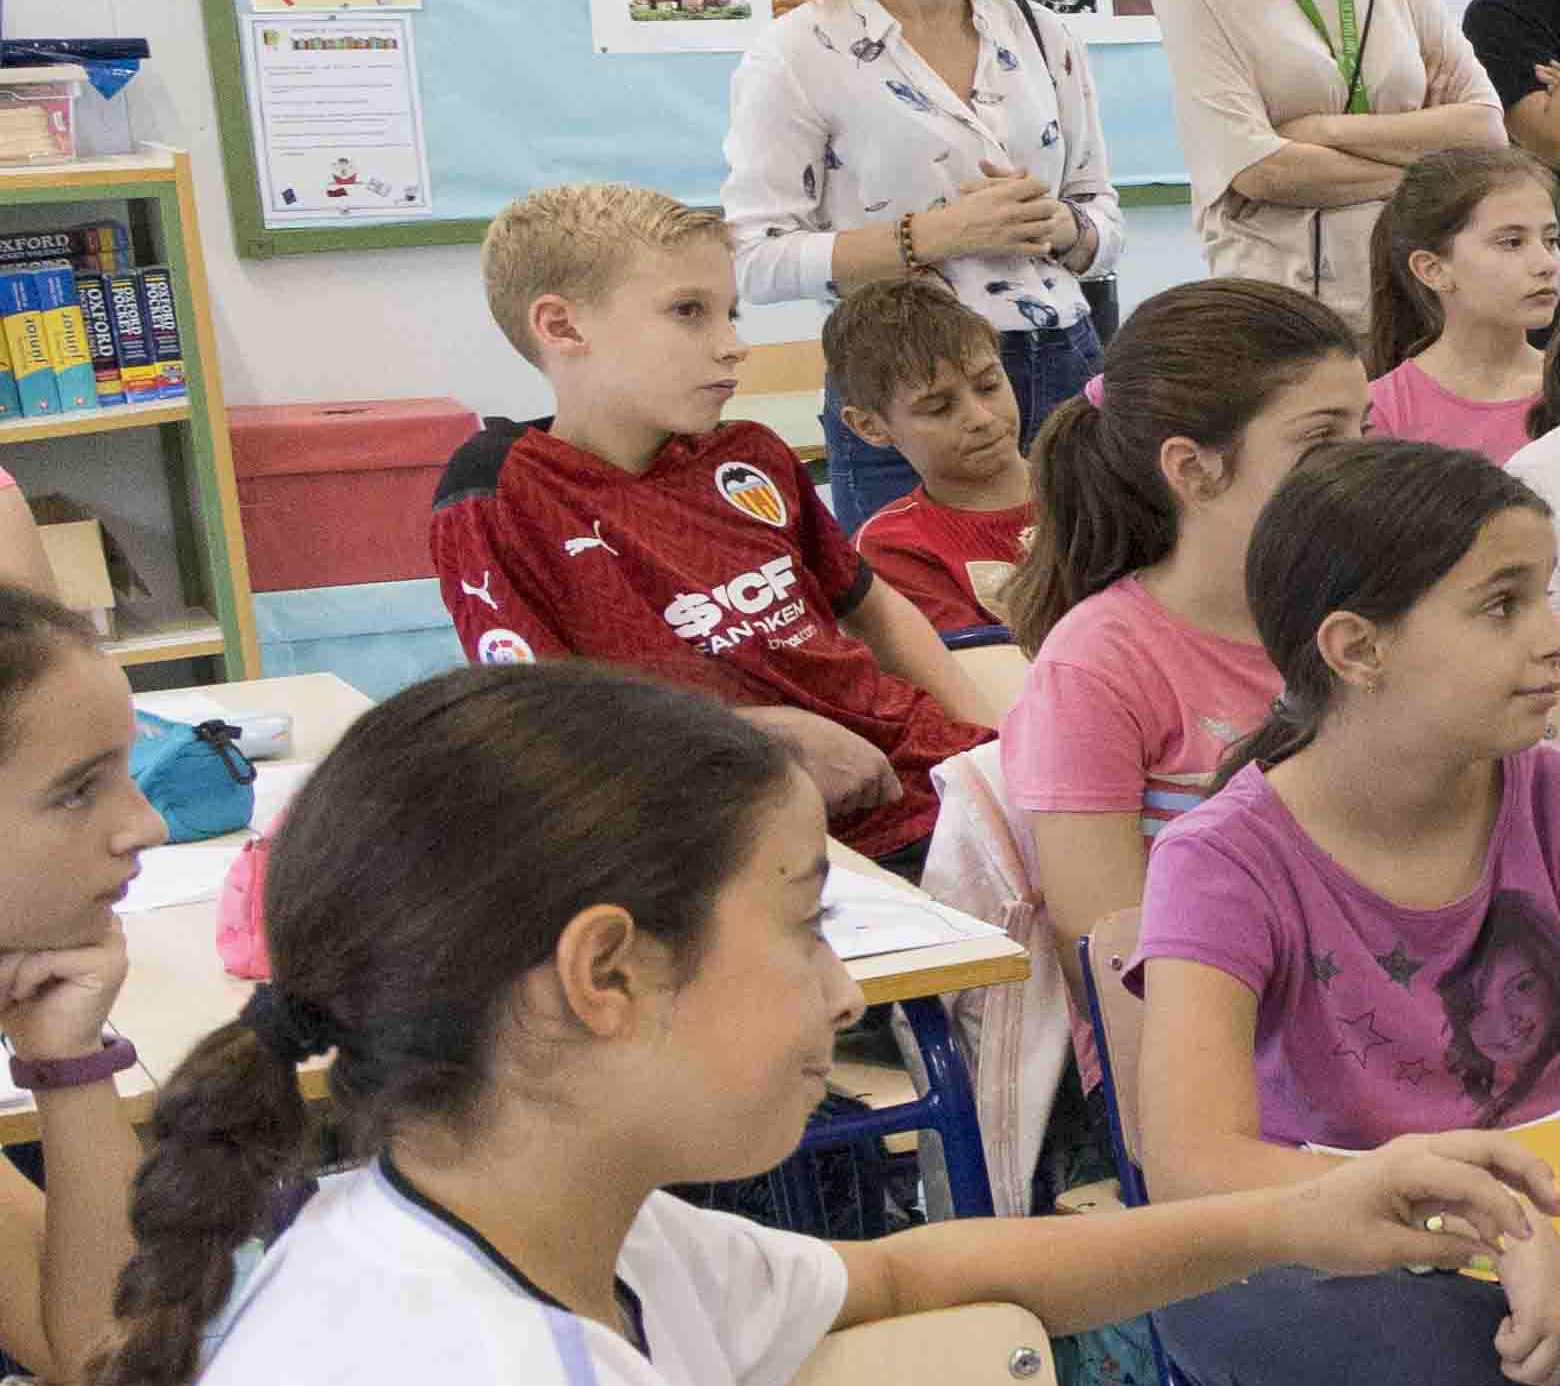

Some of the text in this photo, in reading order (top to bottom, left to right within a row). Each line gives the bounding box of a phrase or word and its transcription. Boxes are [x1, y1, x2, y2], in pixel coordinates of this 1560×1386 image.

[0, 233, 70, 253] XFORD
[87, 288, 114, 357] OXFORD
[112, 289, 130, 335] POCKET
[122, 286, 143, 335] OXFORD
[146, 282, 163, 331] POCKET
[158, 281, 175, 331] OXFORD
